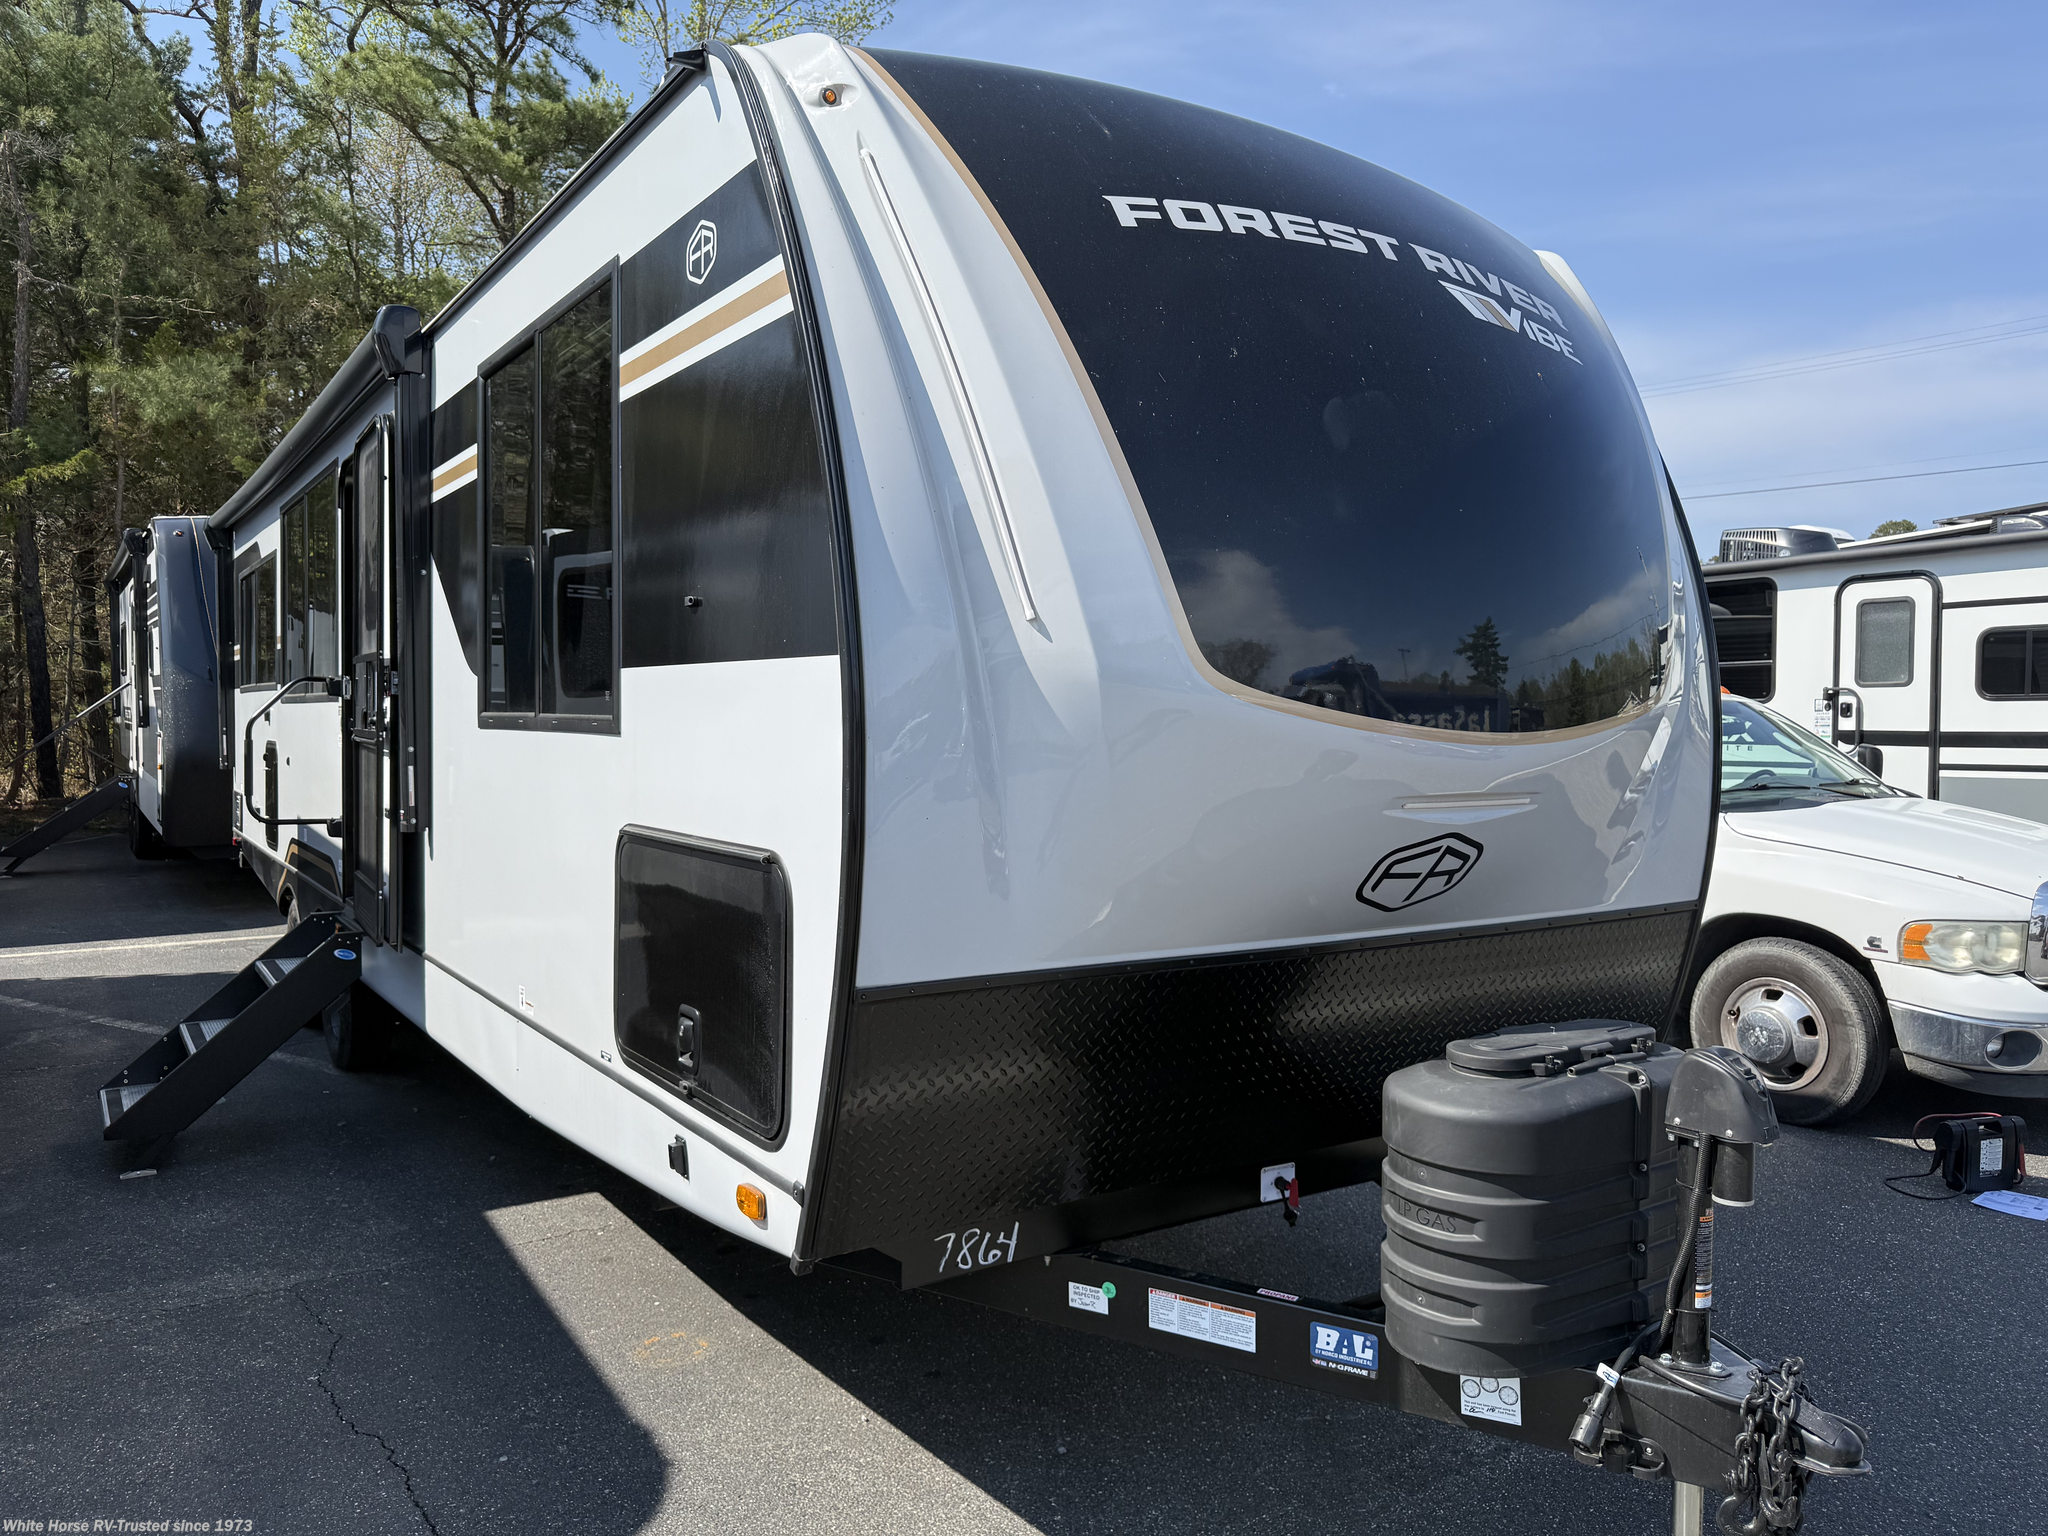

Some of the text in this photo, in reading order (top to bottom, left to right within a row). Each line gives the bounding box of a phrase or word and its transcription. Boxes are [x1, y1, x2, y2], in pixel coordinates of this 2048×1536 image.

[1102, 195, 1568, 331] FOREST RIVER
[1438, 280, 1583, 365] VIBE
[1398, 1199, 1456, 1233] LP GAS
[934, 1221, 1019, 1273] 7864
[1073, 1290, 1101, 1300] INSPECTED
[1260, 1289, 1296, 1300] PROPANE
[1321, 1349, 1338, 1358] NORCO
[1339, 1354, 1366, 1365] INDUSTRIES
[1344, 1365, 1369, 1376] FRAME
